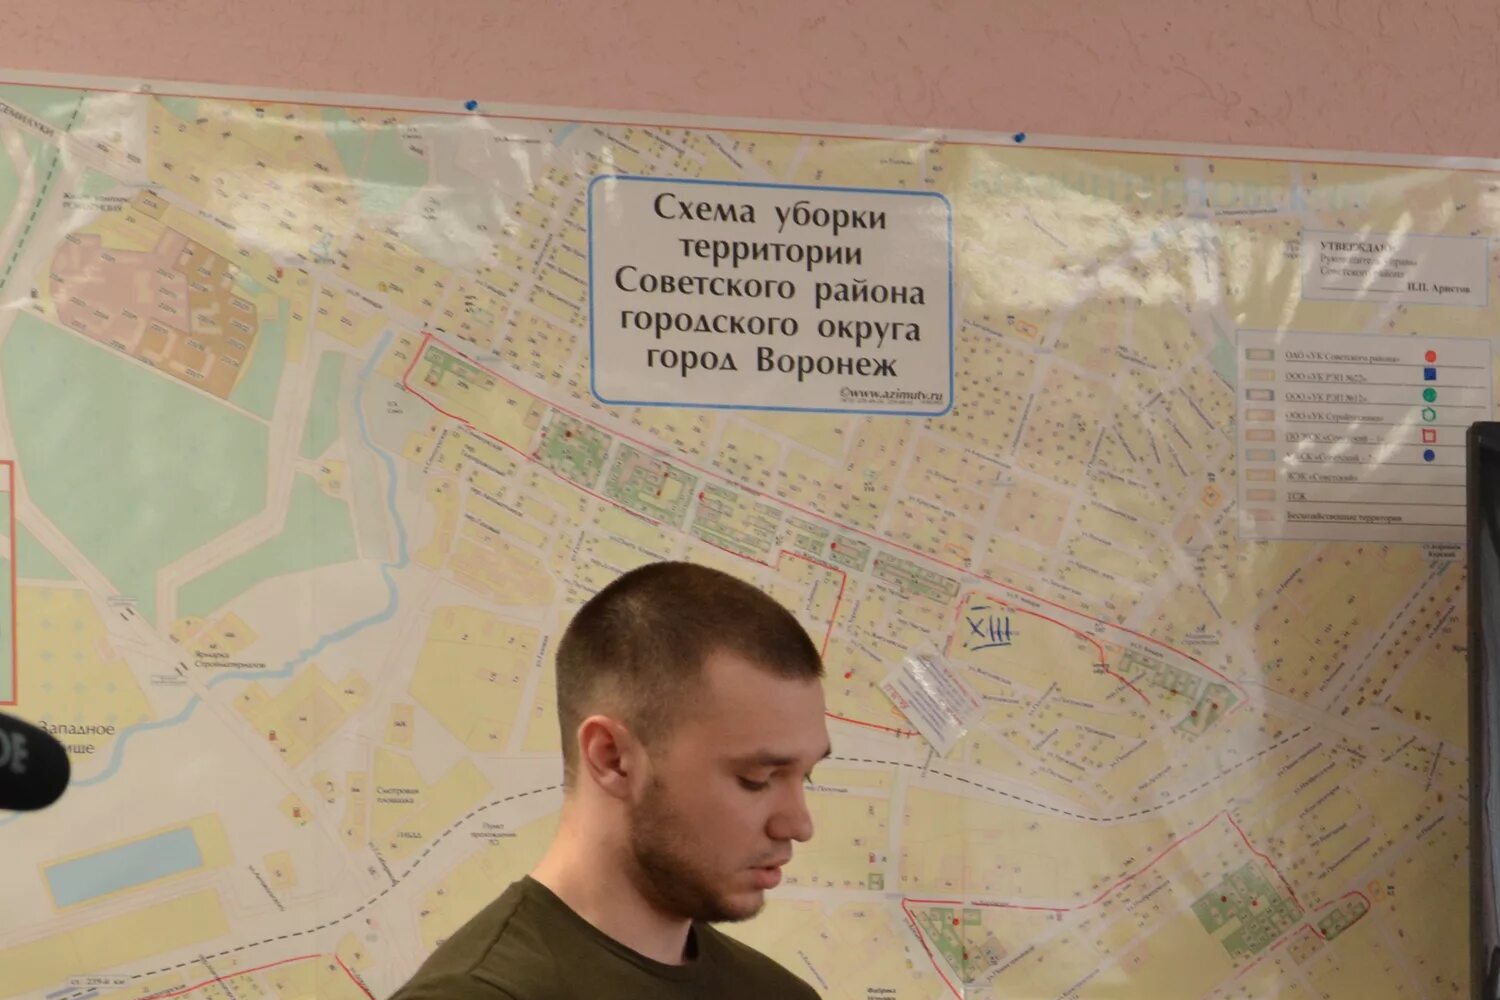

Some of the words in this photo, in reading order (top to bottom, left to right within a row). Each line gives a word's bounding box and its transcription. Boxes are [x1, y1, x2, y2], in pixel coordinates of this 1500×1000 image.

[653, 192, 755, 224] Схема
[775, 201, 887, 235] уборки
[678, 237, 863, 271] территории
[615, 265, 797, 300] Советского
[815, 279, 925, 309] района
[621, 310, 798, 338] городского
[818, 319, 921, 348] округа
[647, 347, 738, 378] город
[756, 347, 898, 382] Воронеж
[39, 721, 115, 736] Западное
